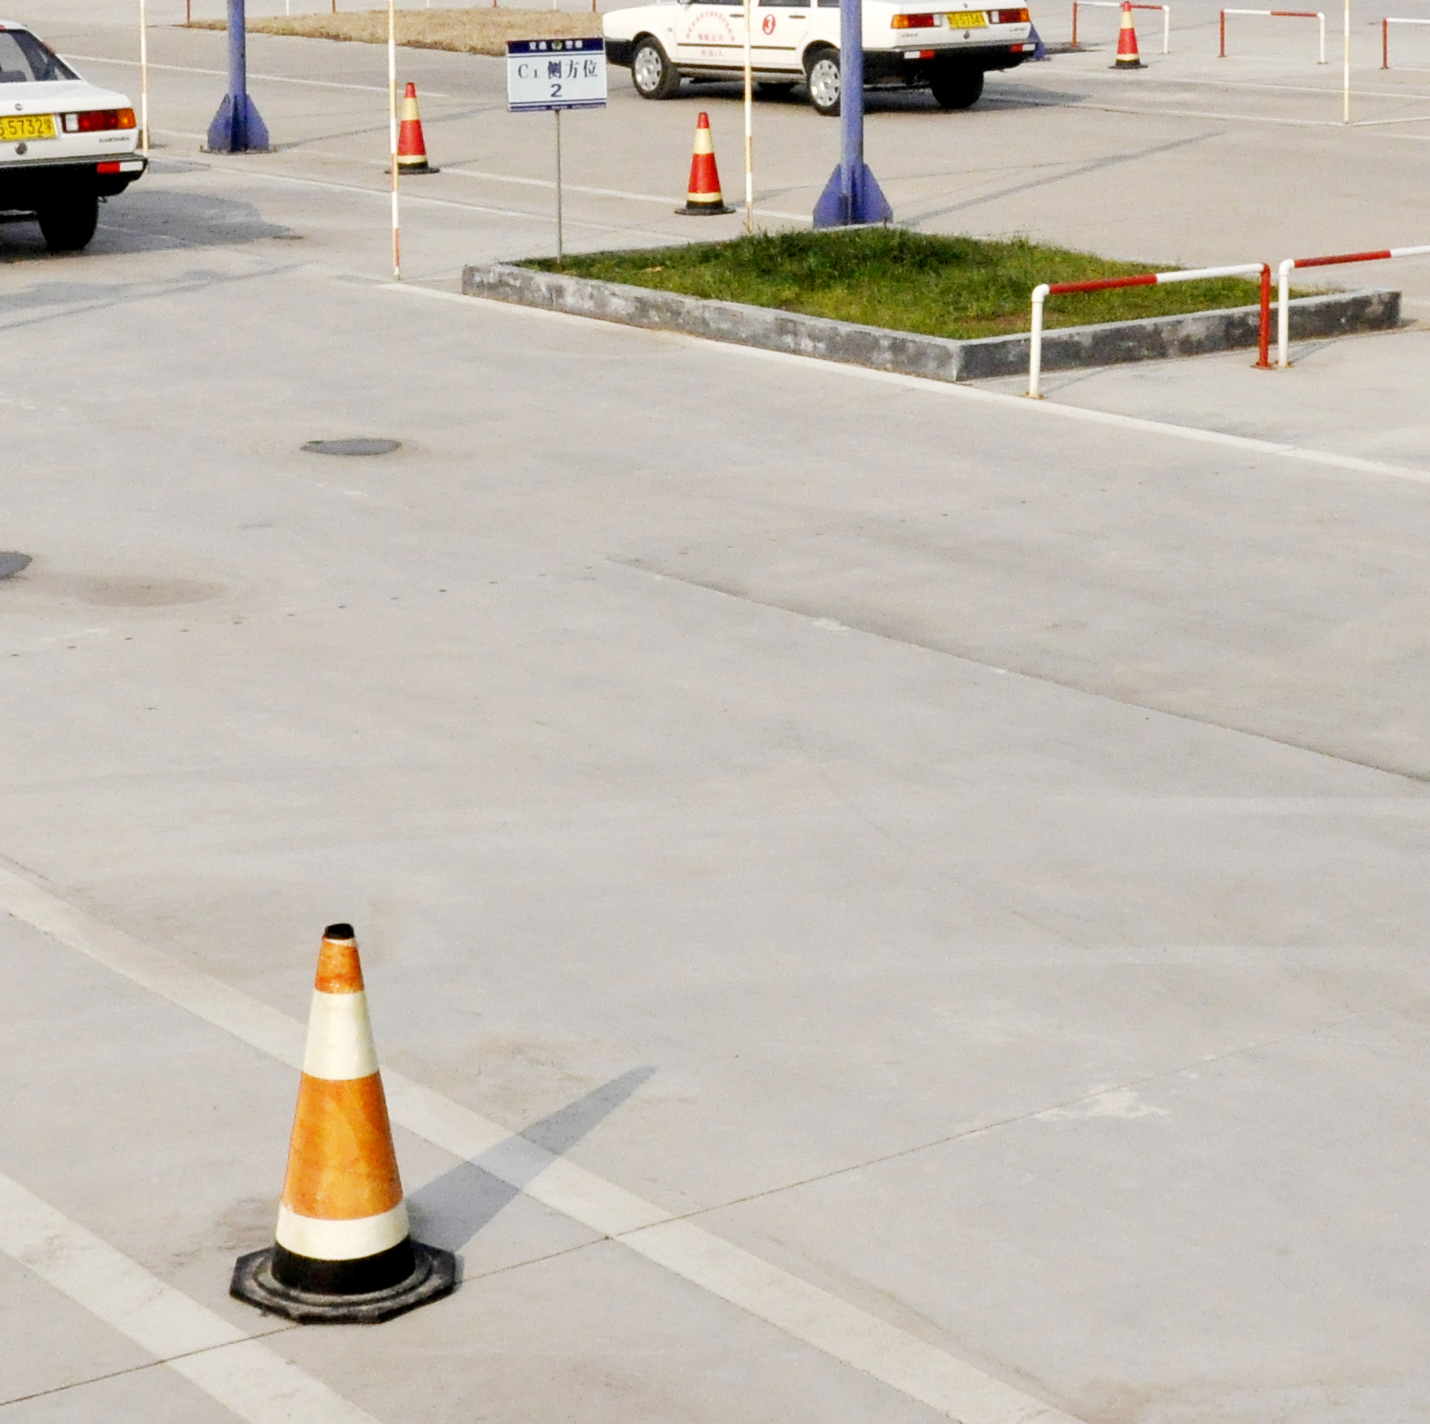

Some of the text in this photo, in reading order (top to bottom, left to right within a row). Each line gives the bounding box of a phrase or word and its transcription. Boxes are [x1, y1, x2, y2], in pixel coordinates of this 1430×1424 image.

[547, 59, 598, 80] 侧方位
[550, 83, 563, 98] 2
